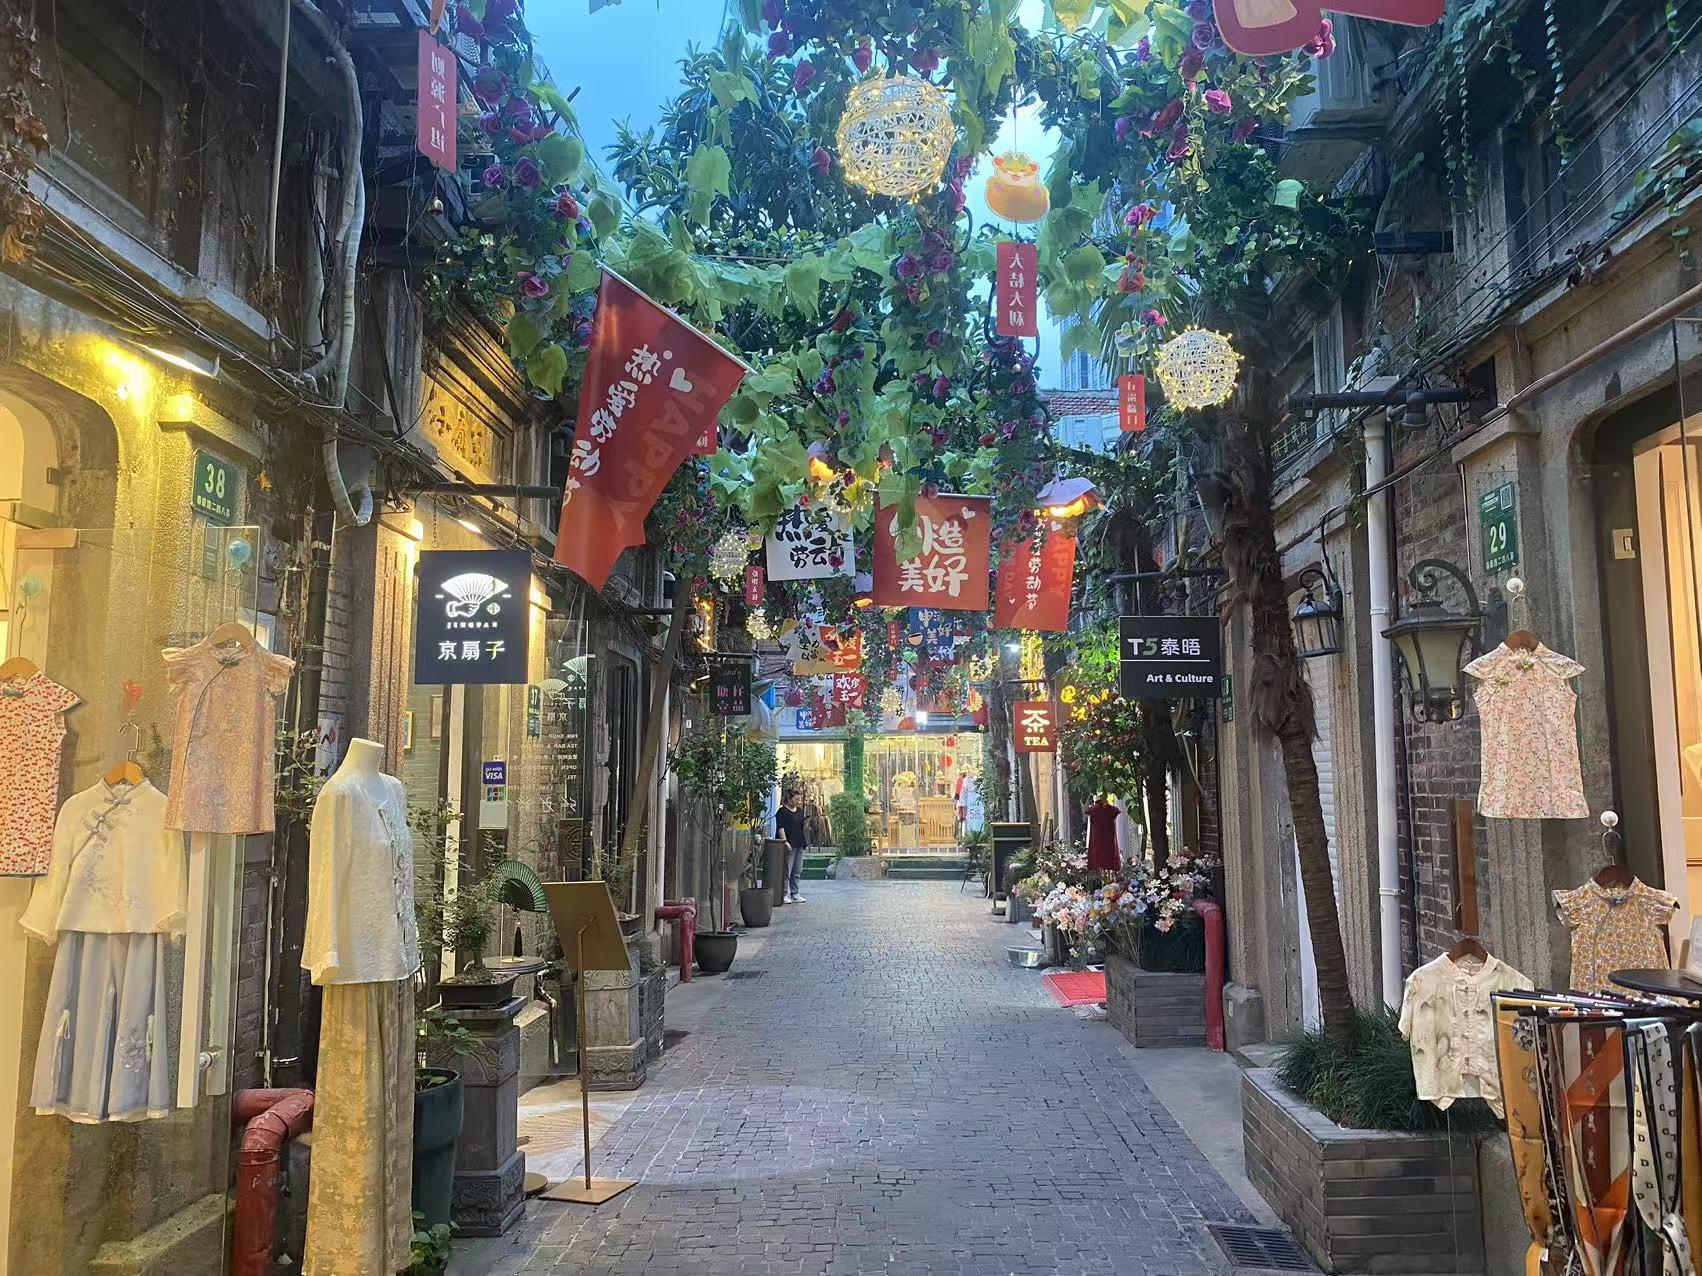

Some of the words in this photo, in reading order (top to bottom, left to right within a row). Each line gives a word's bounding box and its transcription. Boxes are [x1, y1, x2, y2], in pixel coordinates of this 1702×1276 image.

[205, 463, 226, 498] 38
[1490, 521, 1507, 554] 29
[898, 555, 968, 597] 美好
[438, 640, 506, 660] 京扇子
[1146, 674, 1163, 683] Art
[1165, 674, 1173, 683] &
[1175, 673, 1214, 683] Culture
[1021, 709, 1051, 733] 茶
[1023, 736, 1050, 747] TEA
[485, 772, 503, 780] VISA
